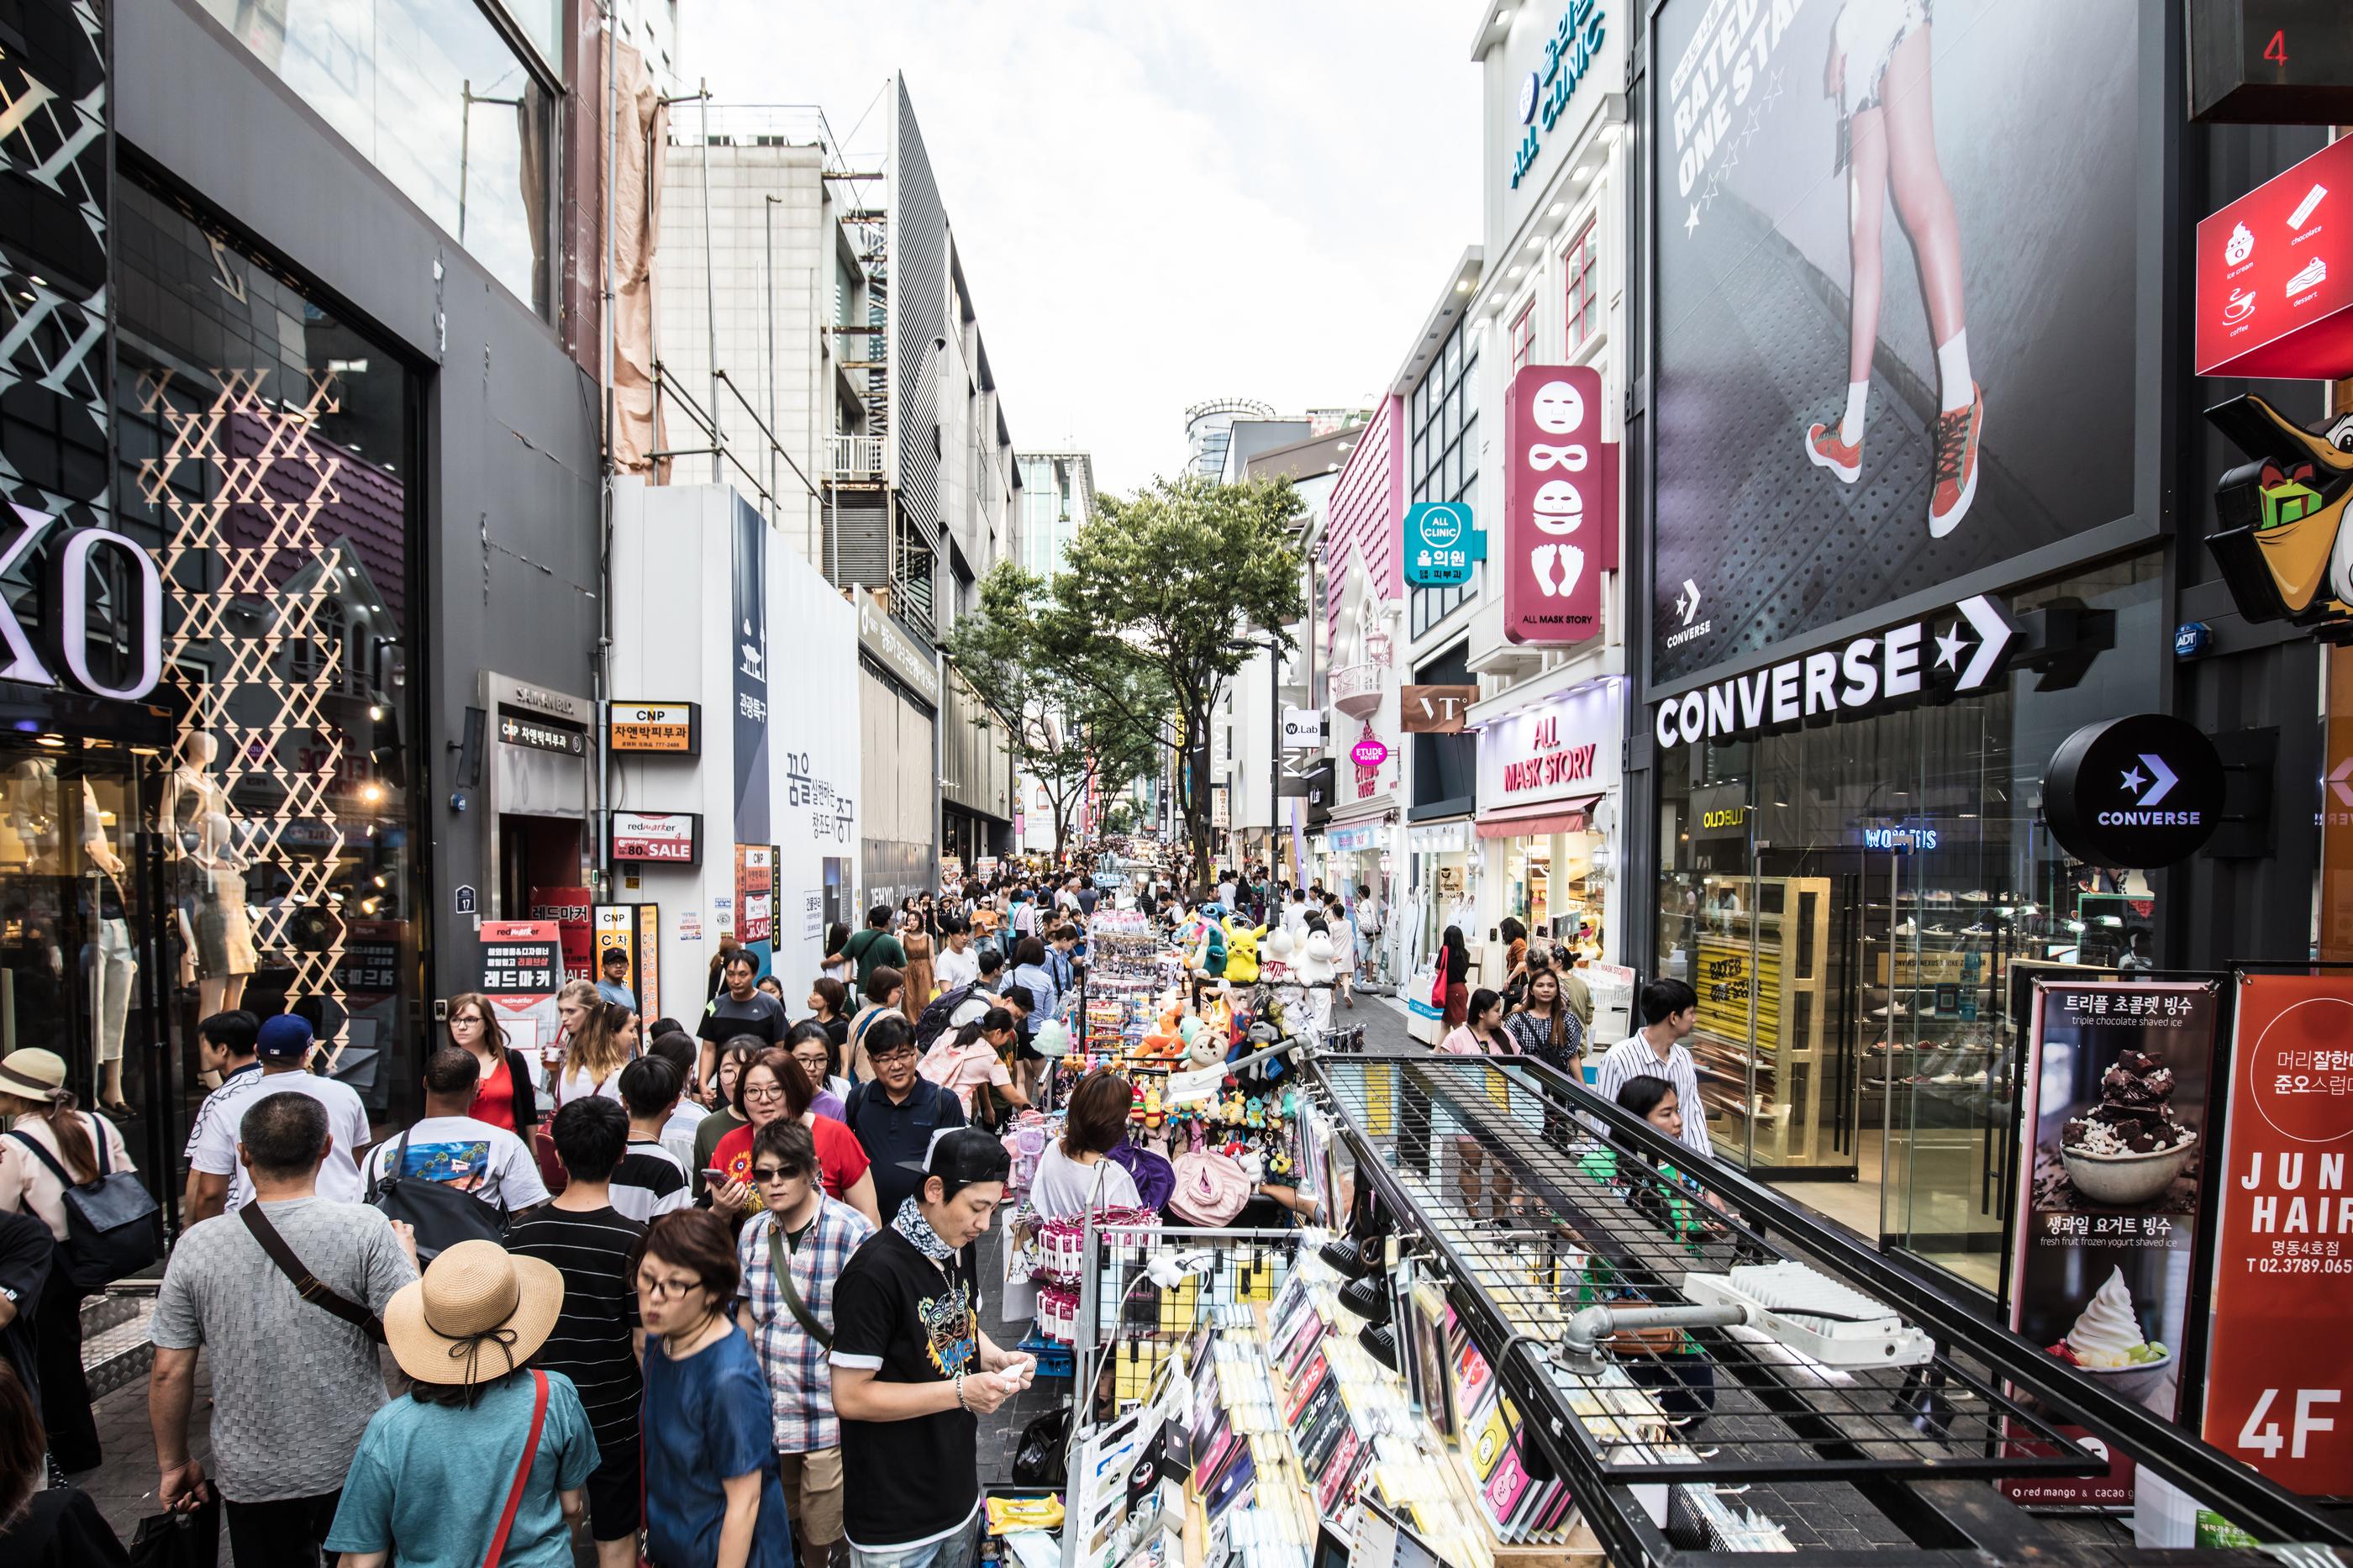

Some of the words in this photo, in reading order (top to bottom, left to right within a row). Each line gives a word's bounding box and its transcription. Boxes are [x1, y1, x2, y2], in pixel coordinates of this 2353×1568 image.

[2263, 29, 2288, 66] 4
[1511, 125, 1540, 189] ALL
[1541, 11, 1605, 132] CLINIC
[1679, 83, 1732, 197] ONE
[2291, 225, 2323, 246] chocolate
[2226, 271, 2235, 280] ice
[2235, 261, 2254, 276] cream
[2293, 291, 2319, 308] dessert
[2229, 324, 2249, 338] coffee
[1432, 517, 1449, 526] ALL
[1424, 528, 1457, 539] CLINIC
[1417, 550, 1466, 568] 올의원
[1434, 570, 1462, 579] 피부과
[1522, 615, 1538, 624] ALL
[1539, 615, 1565, 624] MASK
[1566, 615, 1593, 625] STORY
[1666, 620, 1711, 650] CONVERSE
[2177, 633, 2197, 648] ADT
[1656, 622, 1923, 749] CONVERSE
[636, 710, 666, 721] CNP
[740, 692, 766, 723] 관광특구
[502, 723, 519, 736] CNP
[521, 726, 566, 749] 차앤박피부과
[614, 725, 687, 739] 차앤박피부과
[1533, 716, 1561, 750] ALL
[1213, 709, 1224, 776] KLAVUU
[1355, 747, 1383, 756] ETUDE
[1503, 755, 1544, 793] MASK
[1544, 743, 1597, 786] STORY
[787, 752, 812, 808] 꿈을
[811, 779, 835, 808] 실현하는
[628, 821, 676, 832] redmarker
[834, 797, 854, 844] 중구
[2098, 812, 2201, 826] CONVERSE
[618, 839, 649, 847] everyday
[649, 844, 690, 857] SALE
[462, 899, 471, 909] 17
[531, 904, 589, 922] 레드마커
[603, 913, 625, 923] CNP
[497, 927, 540, 936] redmarker
[756, 919, 770, 939] SALE
[484, 971, 550, 987] 레드마커
[565, 969, 589, 981] ALE
[2064, 994, 2109, 1015] 트리플
[2113, 995, 2159, 1016] 초콜렛
[2164, 996, 2193, 1016] 빙수
[2072, 1015, 2094, 1027] triple
[2096, 1015, 2137, 1026] chocolate
[2139, 1016, 2169, 1027] shaved
[2171, 1017, 2183, 1027] ice
[2047, 1216, 2089, 1235] 생과일
[2093, 1217, 2138, 1235] 요거트
[2143, 1218, 2172, 1236] 빙수
[2040, 1236, 2061, 1247] fresh
[2061, 1236, 2079, 1247] fruit
[2080, 1237, 2107, 1247] frozen
[2107, 1238, 2135, 1249] yogurt
[2135, 1237, 2164, 1248] shaved
[2165, 1238, 2178, 1248] ice
[2271, 1240, 2340, 1256] 명동4호점
[2246, 1258, 2256, 1273] T
[2237, 1388, 2342, 1458] 4F
[2024, 1487, 2040, 1497] red
[2043, 1488, 2076, 1499] mango
[2082, 1489, 2087, 1497] &
[2095, 1488, 2124, 1497] cacao
